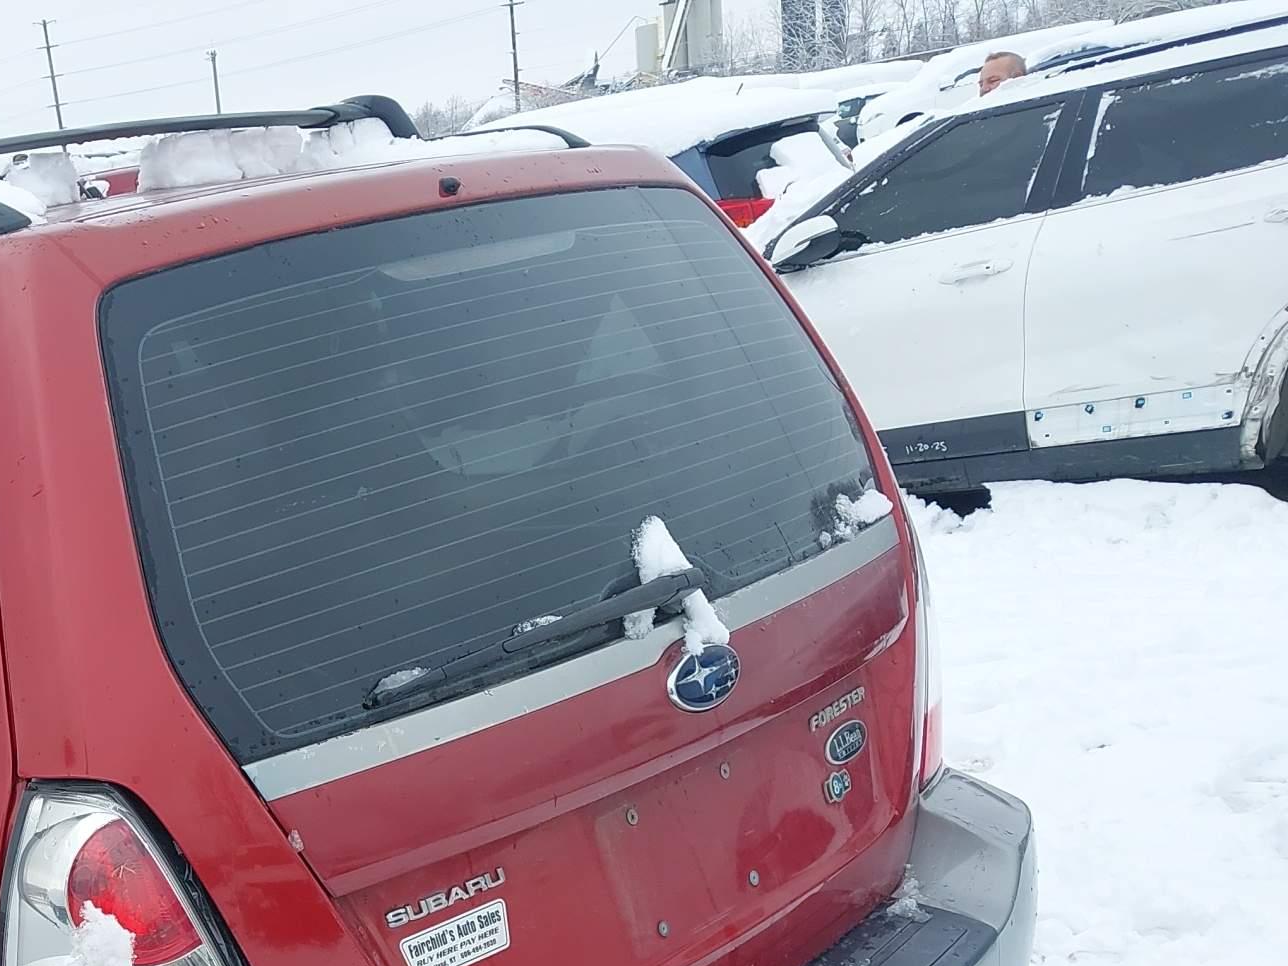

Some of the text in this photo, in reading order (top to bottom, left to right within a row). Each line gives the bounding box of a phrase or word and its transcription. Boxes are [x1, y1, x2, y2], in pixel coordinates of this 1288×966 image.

[810, 686, 866, 732] FORESTER
[385, 867, 506, 928] SUBARU
[407, 910, 501, 960] Fairchild's Auto Sales
[436, 944, 459, 960] HERE
[460, 935, 477, 950] PAY
[478, 926, 501, 941] HERE
